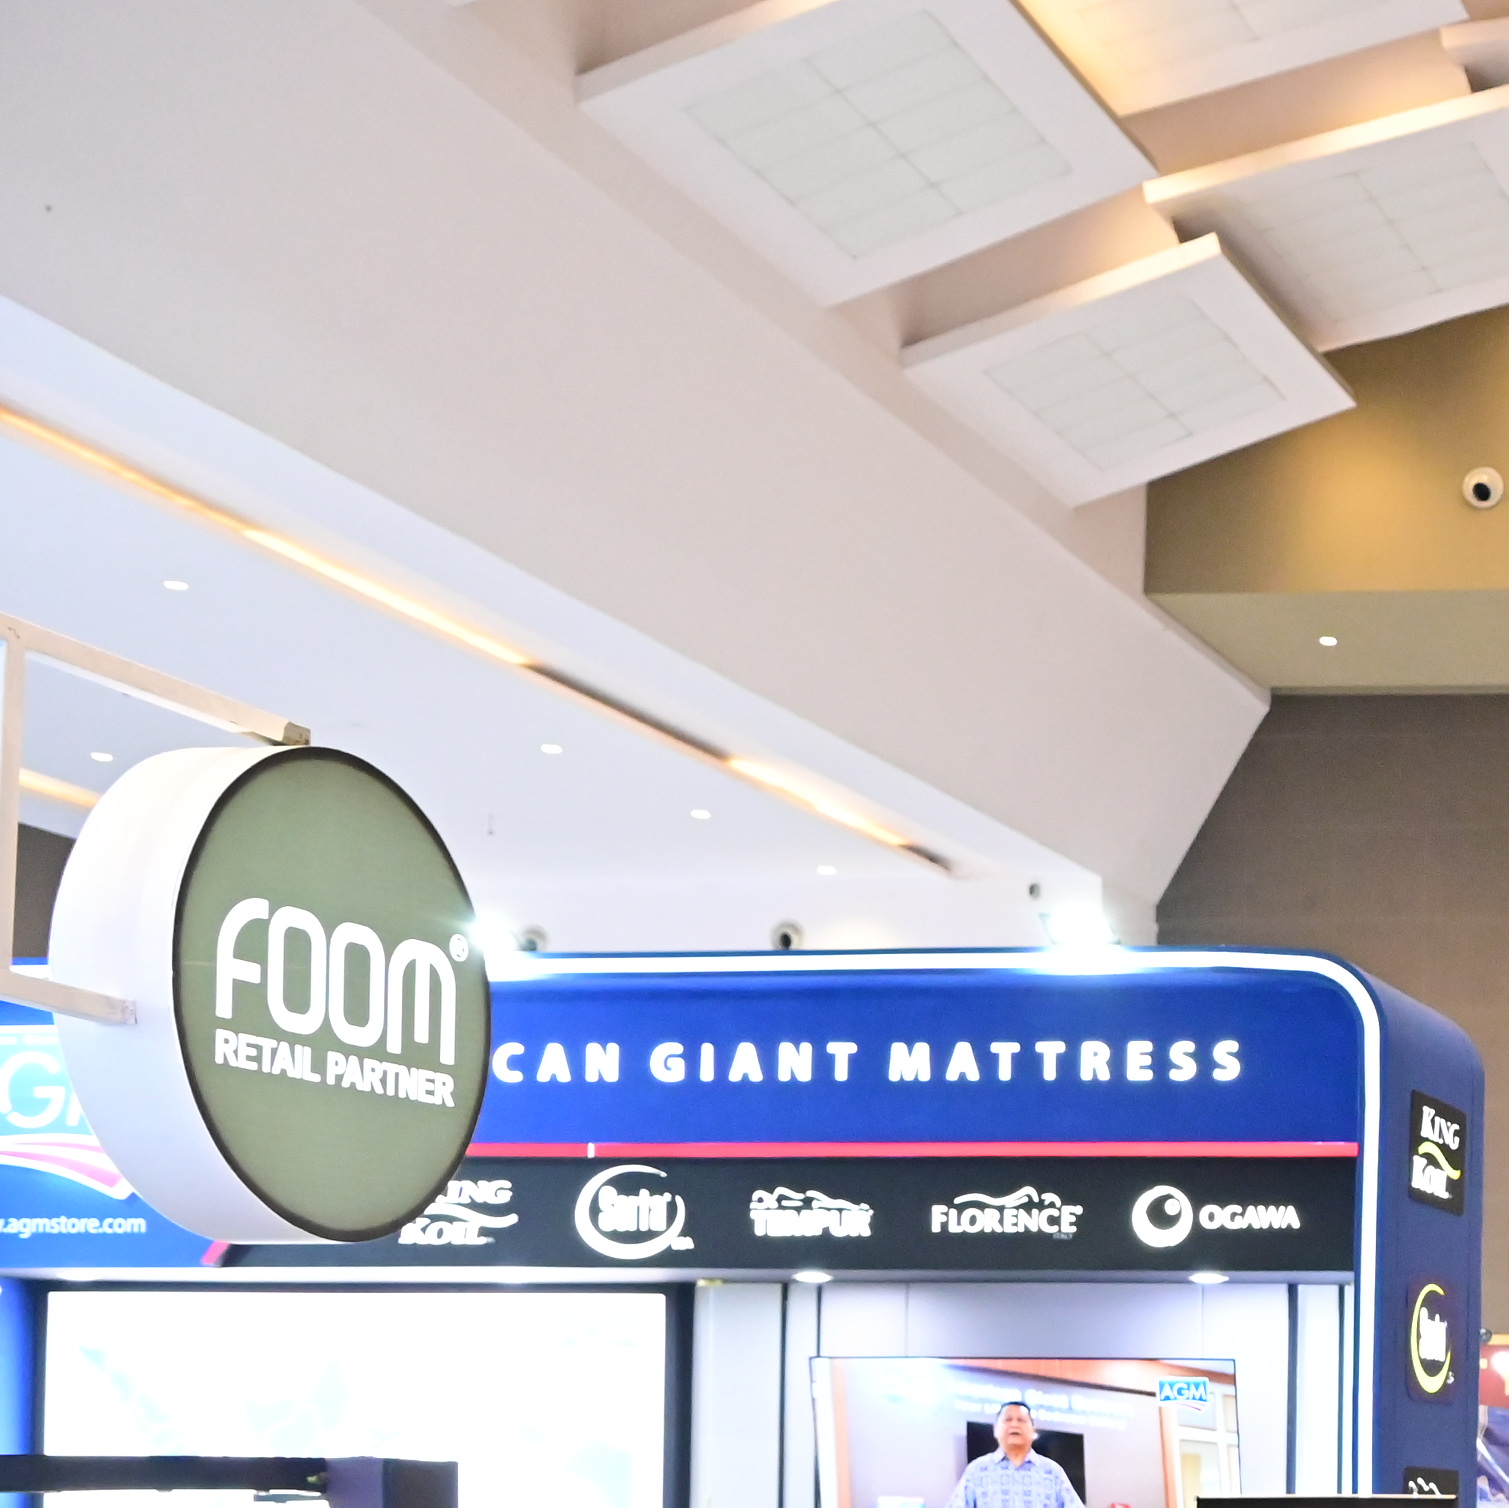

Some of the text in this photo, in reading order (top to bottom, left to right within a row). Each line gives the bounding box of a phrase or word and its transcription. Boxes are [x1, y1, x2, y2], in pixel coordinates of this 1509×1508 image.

[215, 897, 456, 1066] FOOM
[215, 1028, 455, 1107] RETAIL PARTNER
[492, 1040, 1242, 1083] CAN GIANT MATTRESS
[1420, 1105, 1460, 1150] KING
[0, 1215, 147, 1239] .agmstore.com
[931, 1204, 1078, 1234] FLORENCE
[1200, 1205, 1301, 1230] OGAWA
[1159, 1381, 1207, 1401] AGM
